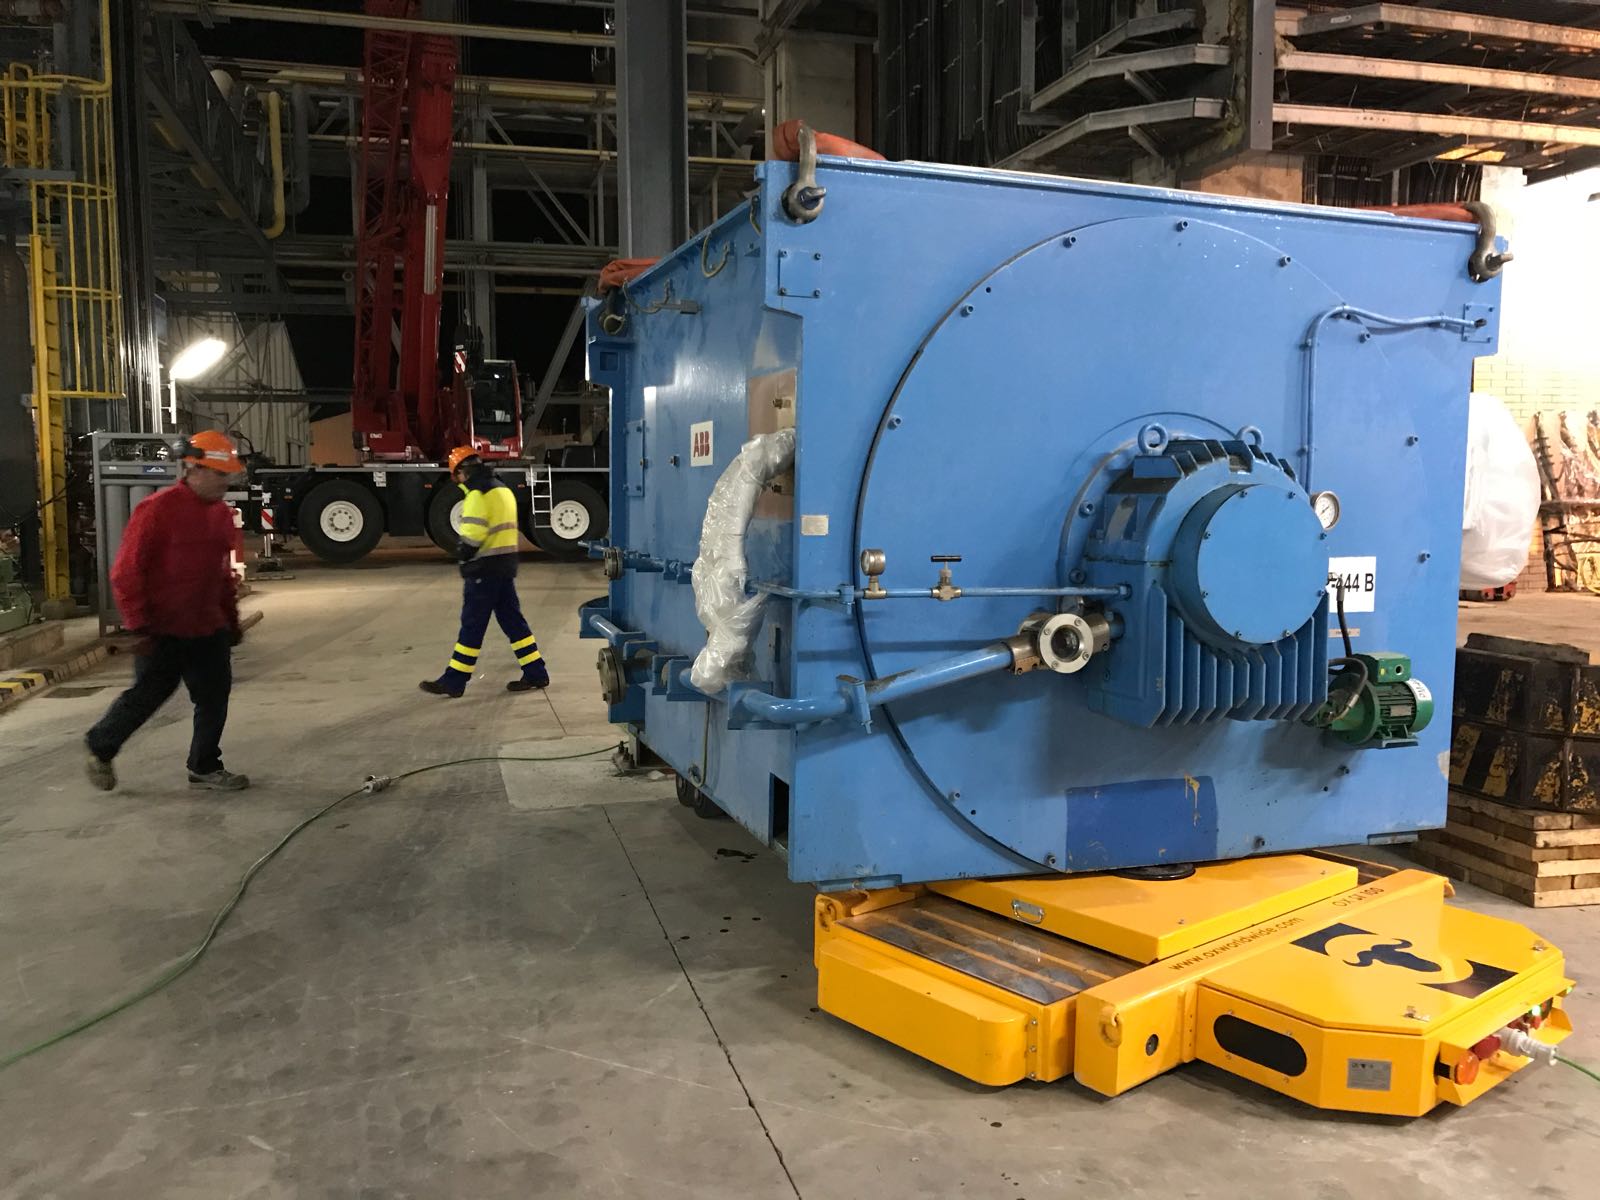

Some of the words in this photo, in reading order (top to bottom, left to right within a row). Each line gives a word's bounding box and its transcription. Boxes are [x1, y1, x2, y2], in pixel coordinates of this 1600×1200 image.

[693, 430, 710, 458] ABB
[1365, 573, 1374, 592] B
[1168, 916, 1304, 971] www.oxworldwide.com
